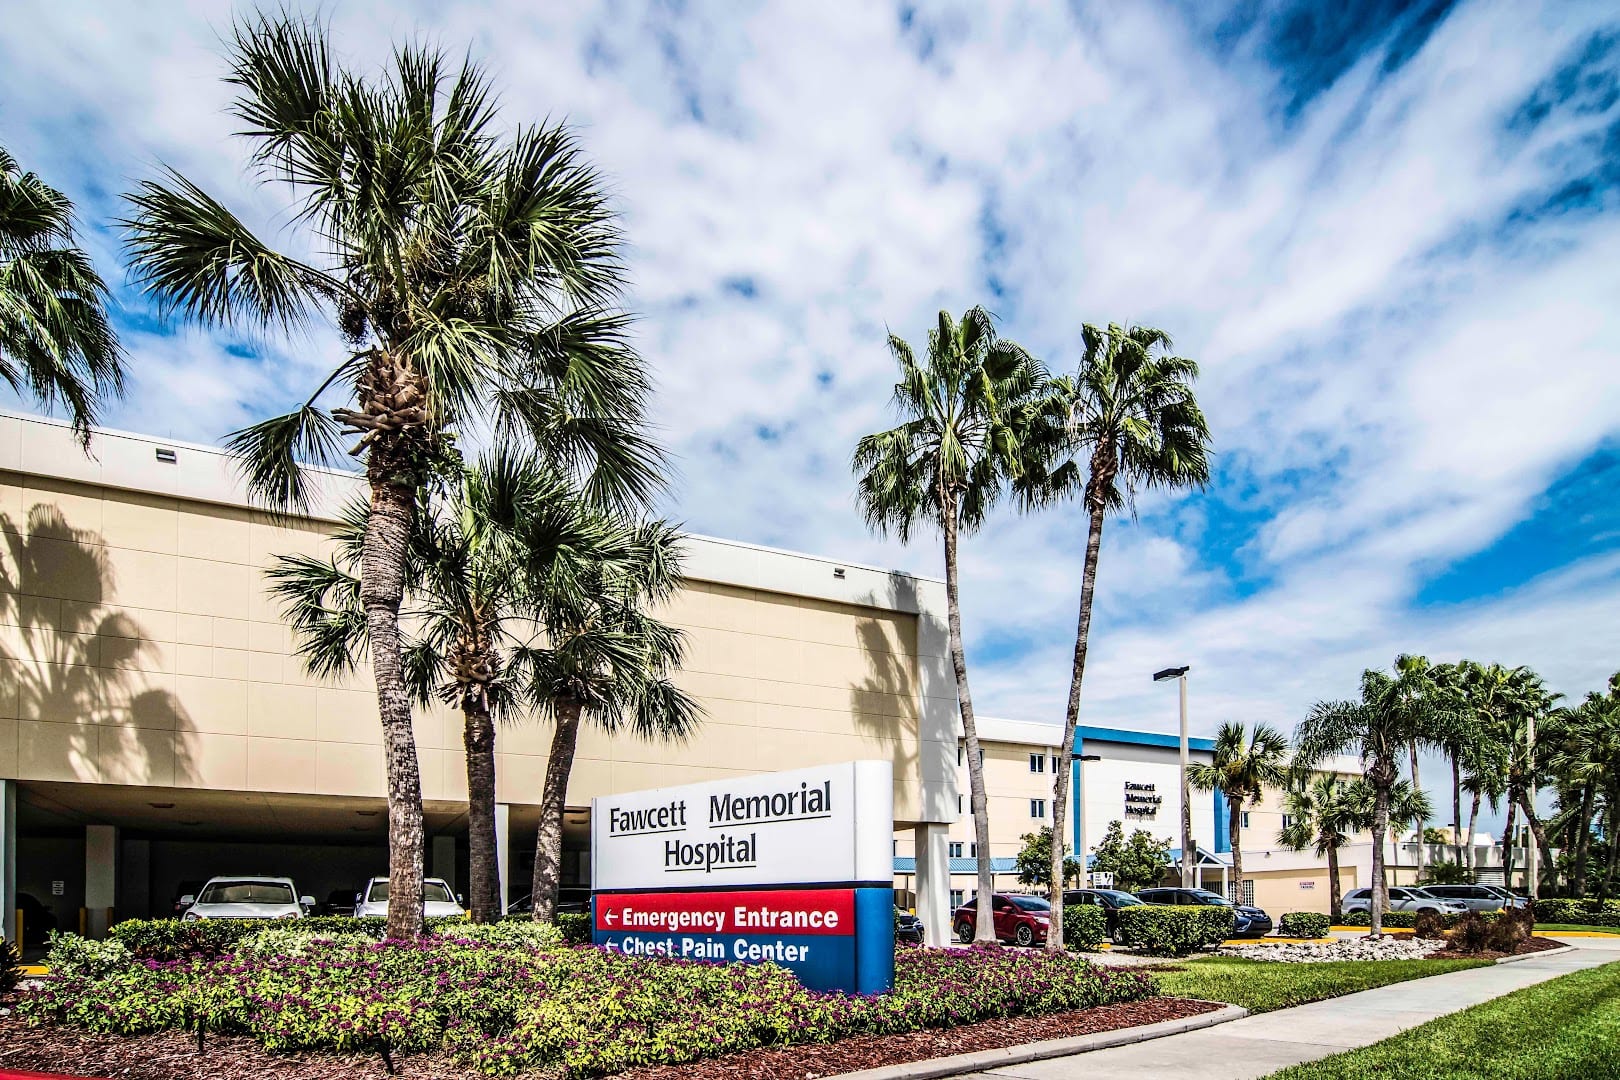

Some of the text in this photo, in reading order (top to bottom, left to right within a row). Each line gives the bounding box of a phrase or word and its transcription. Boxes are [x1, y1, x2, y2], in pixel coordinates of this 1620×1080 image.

[610, 780, 831, 833] Fawcett Memorial
[665, 833, 757, 874] Hospital
[622, 907, 839, 932] Emergency Entrance
[622, 936, 808, 962] Chest Pain Center
